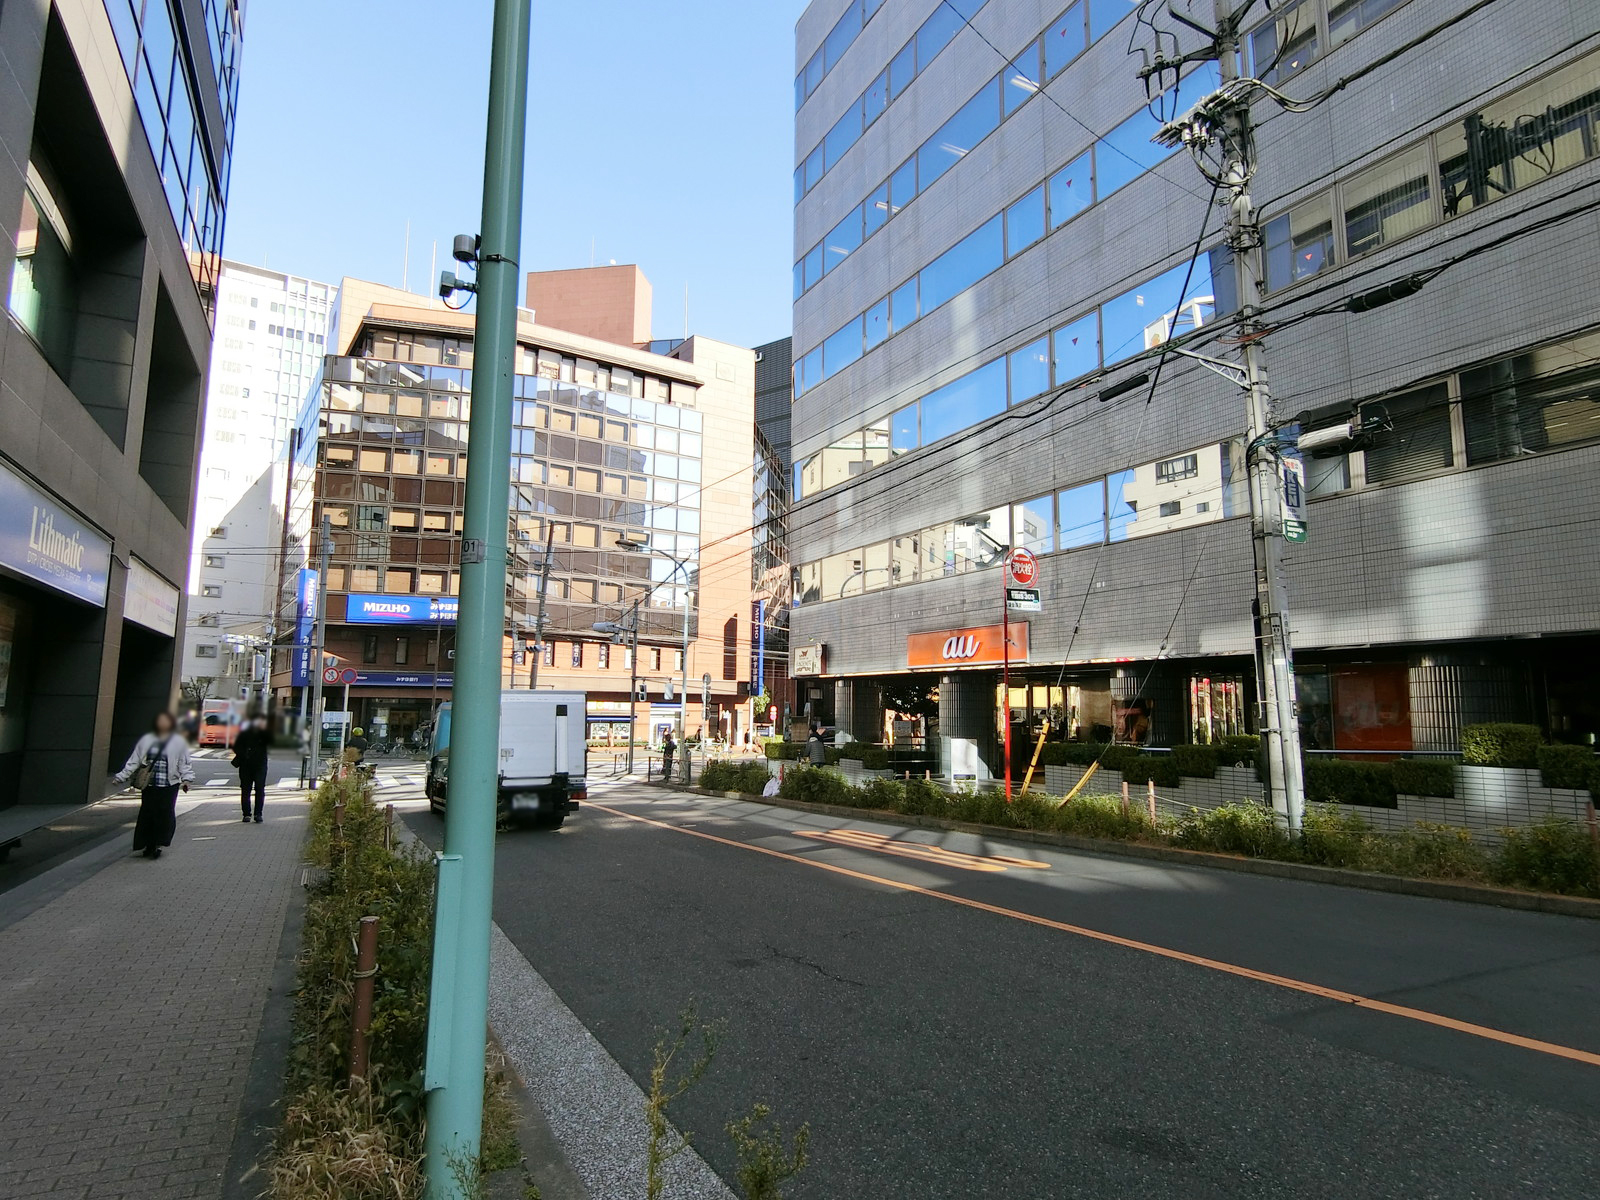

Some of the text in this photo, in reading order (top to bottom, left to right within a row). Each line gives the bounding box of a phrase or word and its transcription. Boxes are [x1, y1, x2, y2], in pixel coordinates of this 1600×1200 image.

[1286, 470, 1298, 507] KEN
[29, 506, 85, 572] Lithmatic
[463, 541, 476, 553] 01
[1012, 562, 1032, 575] 消火栓
[306, 577, 316, 617] MIZUHO
[363, 602, 411, 613] MIZUHO
[942, 635, 980, 659] au
